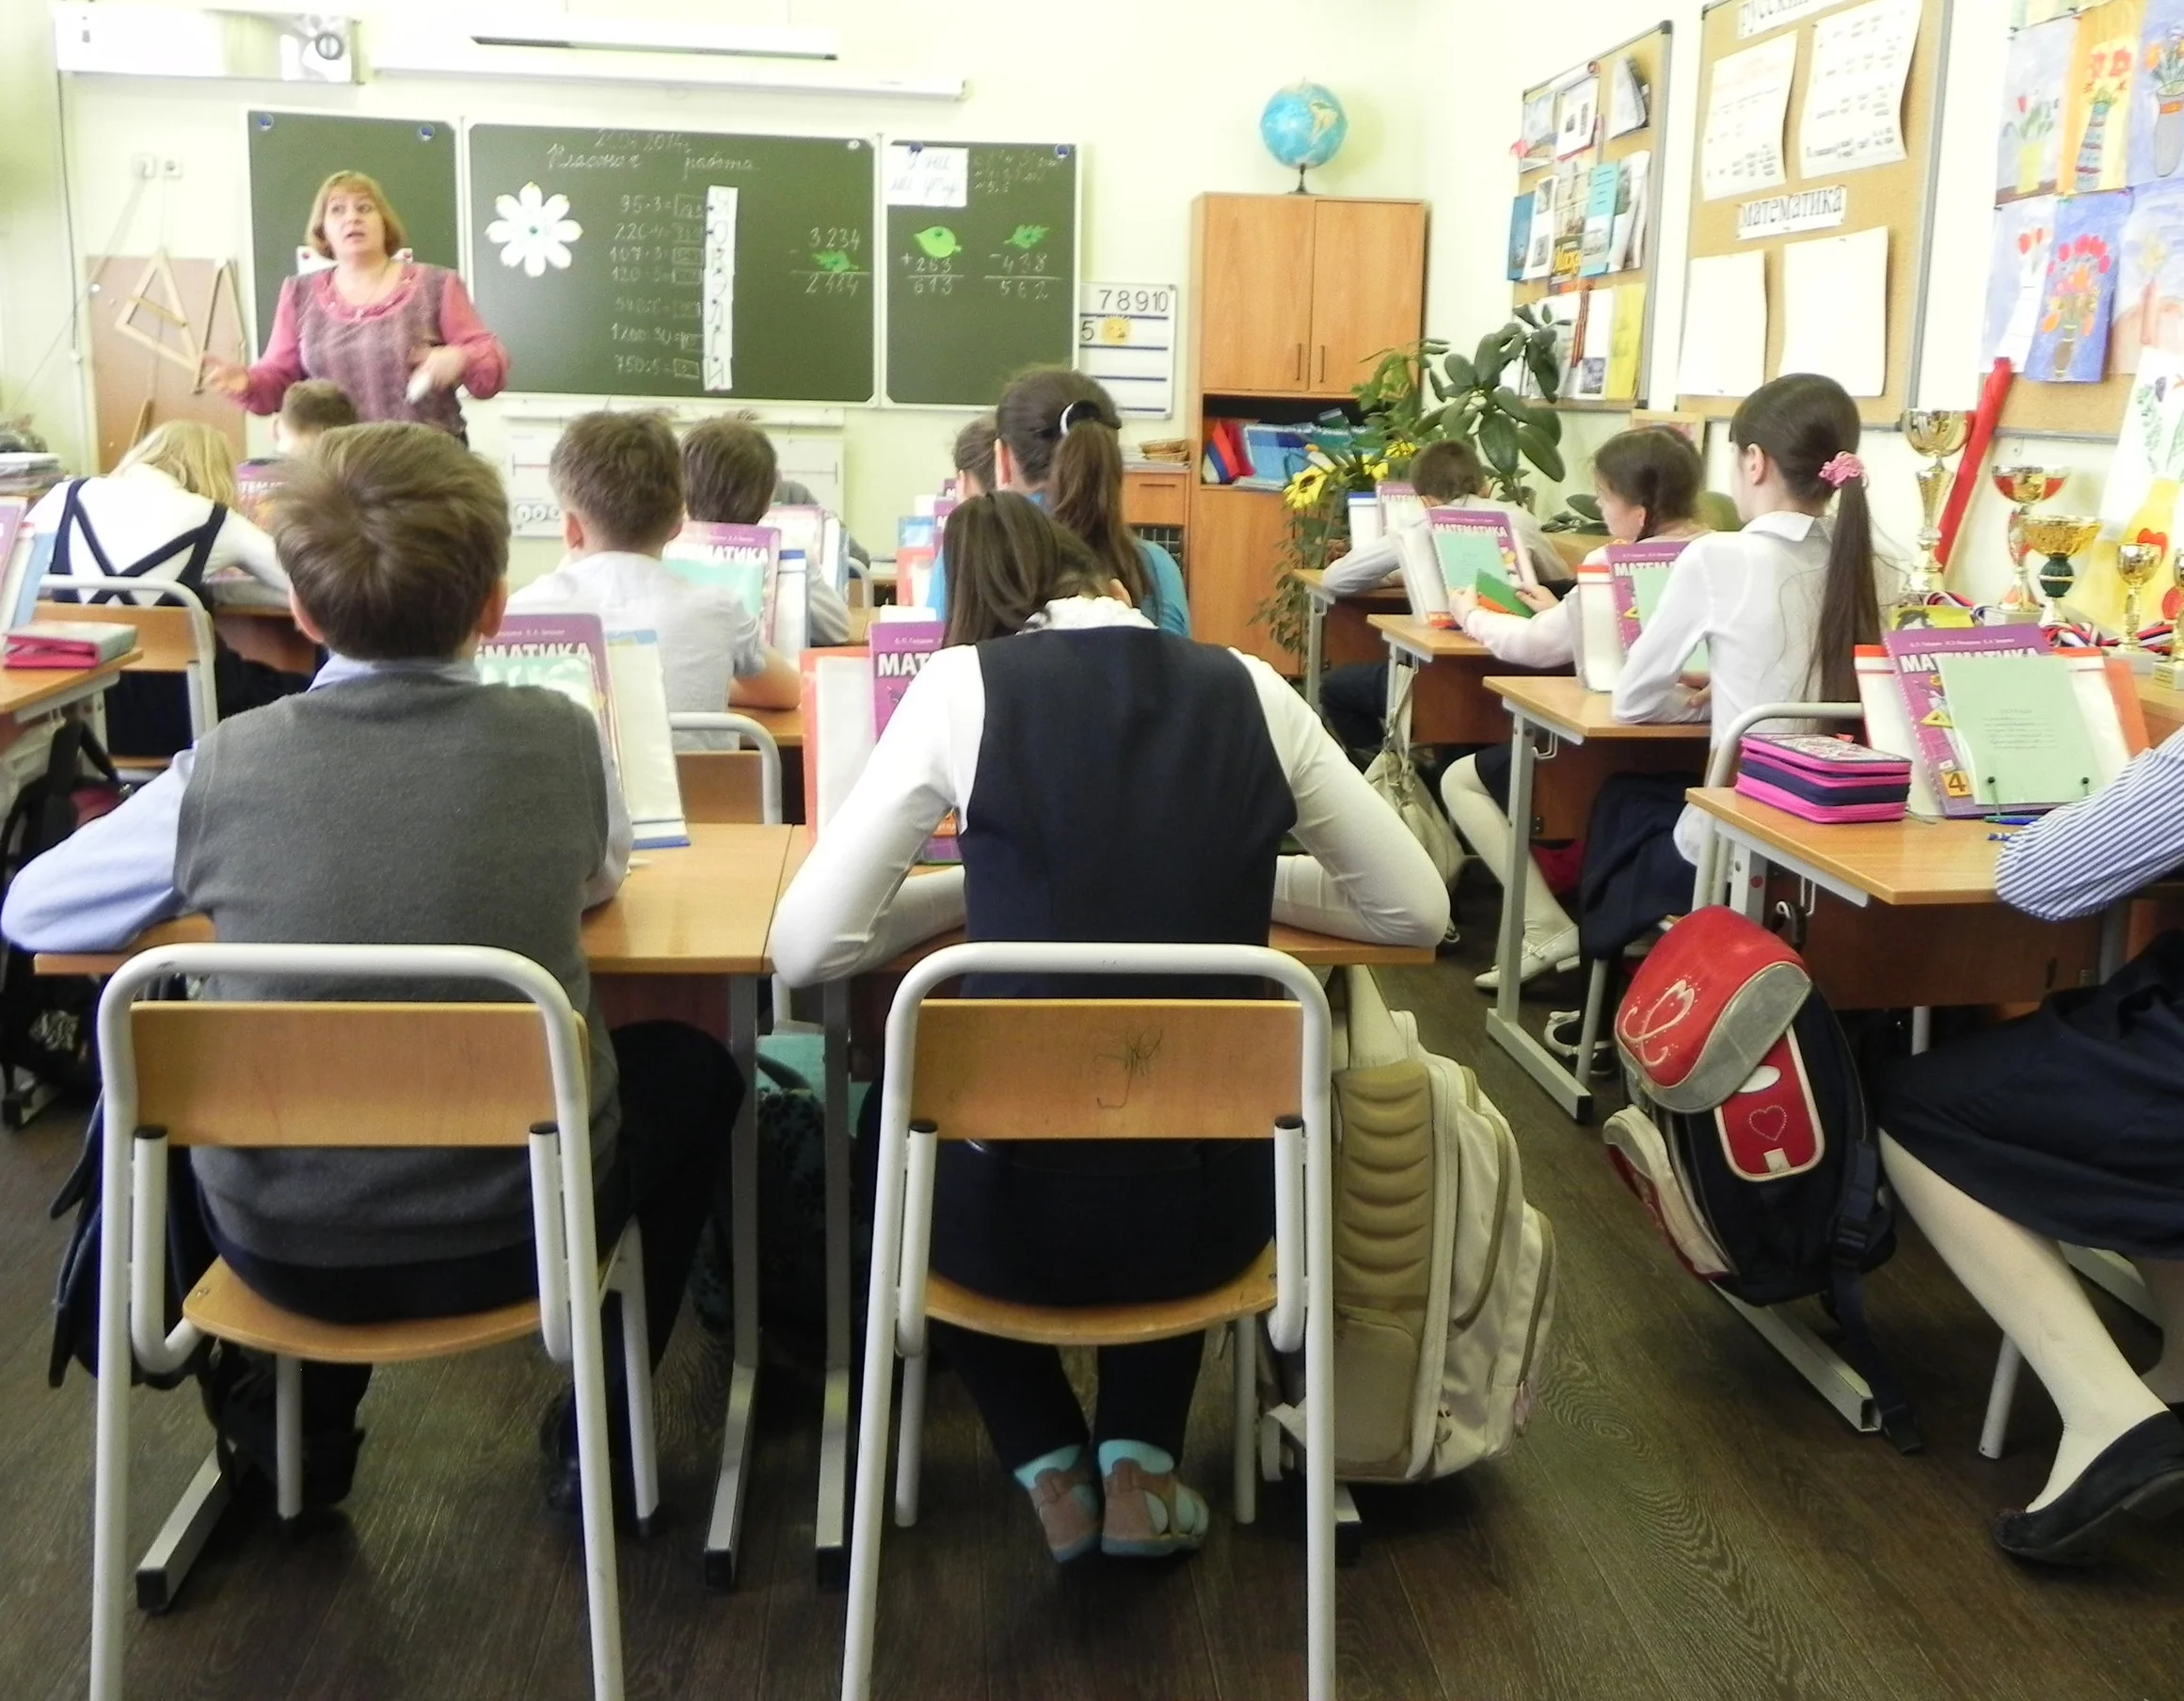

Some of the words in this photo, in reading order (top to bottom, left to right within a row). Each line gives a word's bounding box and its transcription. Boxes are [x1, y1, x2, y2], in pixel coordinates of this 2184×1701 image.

[1743, 187, 1842, 227] математика
[809, 226, 860, 251] 3234
[1099, 290, 1112, 310] 7
[1117, 290, 1130, 311] 8
[1136, 291, 1149, 311] 9
[1152, 291, 1169, 312] 10
[1081, 320, 1094, 342] 5
[1432, 523, 1508, 537] МАТЕМАТИКА
[1948, 772, 1967, 792] 4
